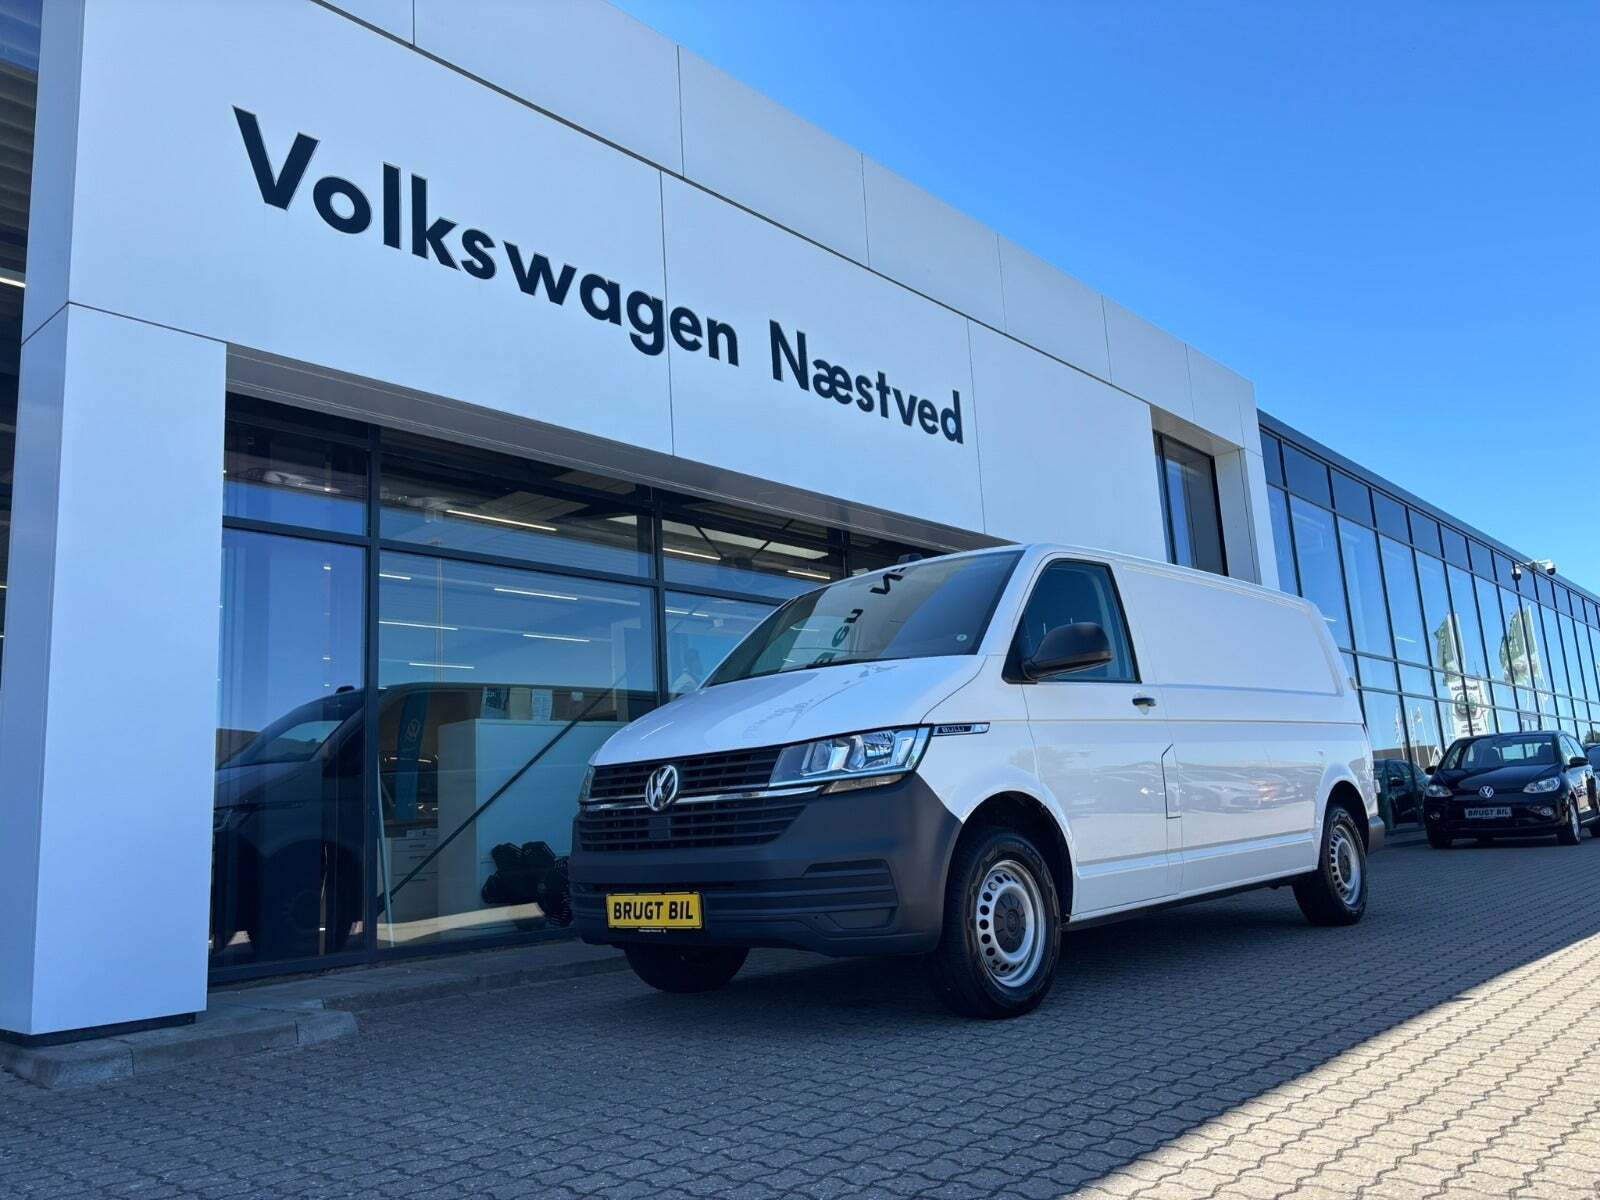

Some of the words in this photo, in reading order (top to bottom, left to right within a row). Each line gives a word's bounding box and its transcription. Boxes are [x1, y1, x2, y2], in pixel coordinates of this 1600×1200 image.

[233, 105, 739, 367] Volkswagen
[769, 319, 964, 445] Næstved
[613, 901, 664, 921] BRUGT
[668, 900, 693, 920] BIL
